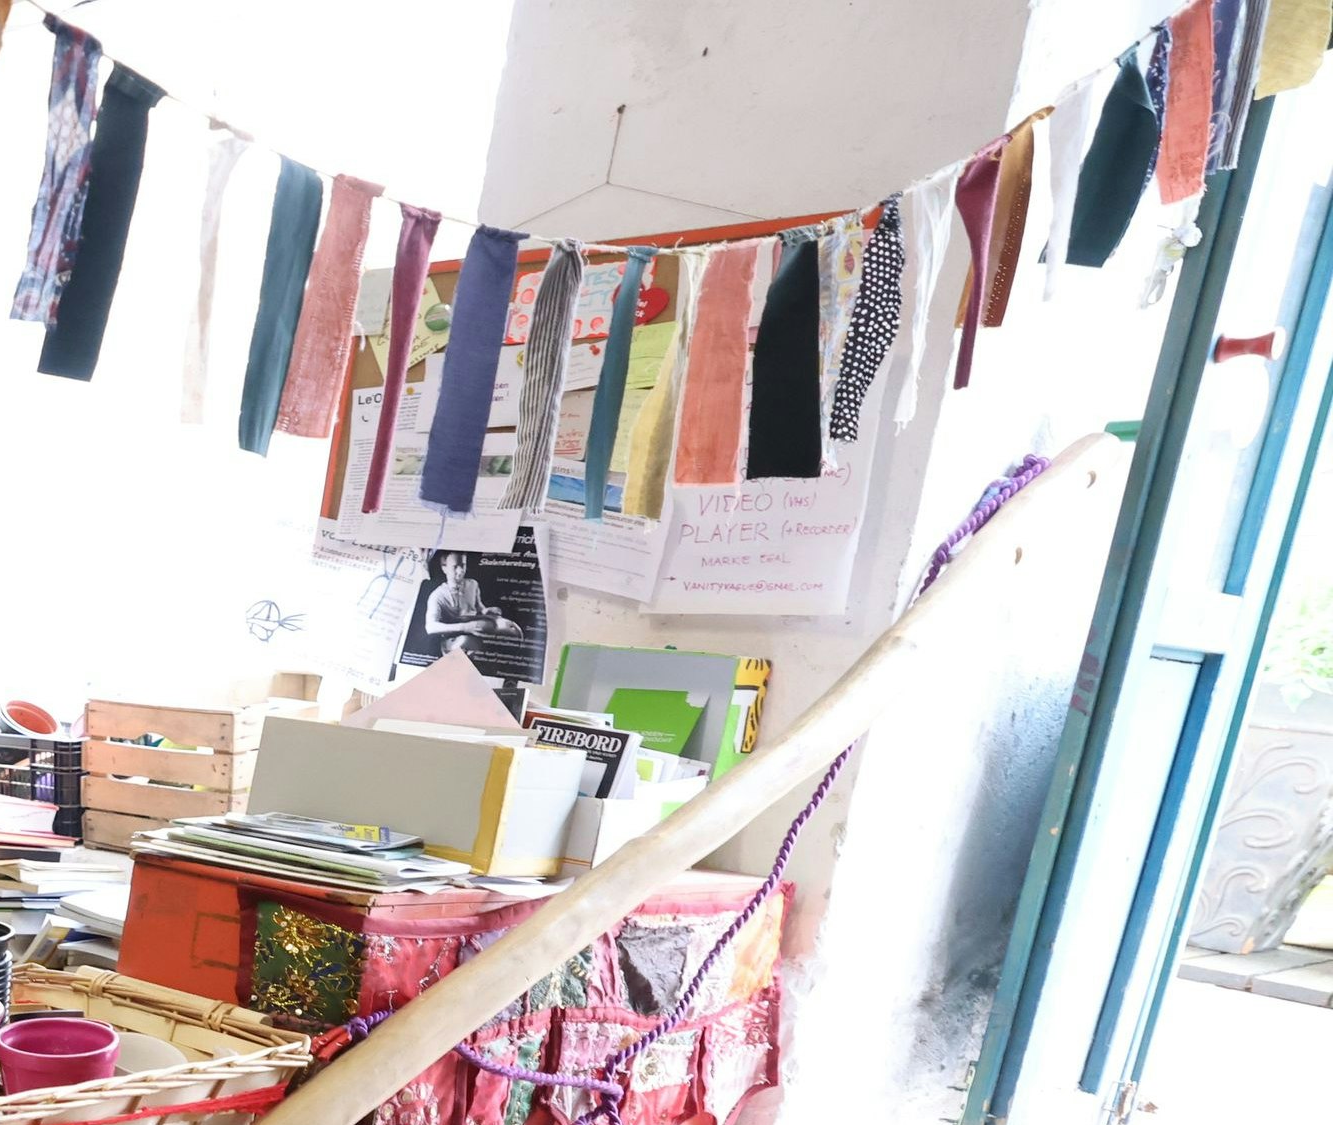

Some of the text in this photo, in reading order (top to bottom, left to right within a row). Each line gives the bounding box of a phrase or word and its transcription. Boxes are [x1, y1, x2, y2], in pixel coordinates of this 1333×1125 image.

[699, 493, 774, 516] VIDEO
[678, 521, 771, 545] PLAYER
[701, 554, 751, 567] MARKE
[535, 724, 623, 754] FIREBORD
